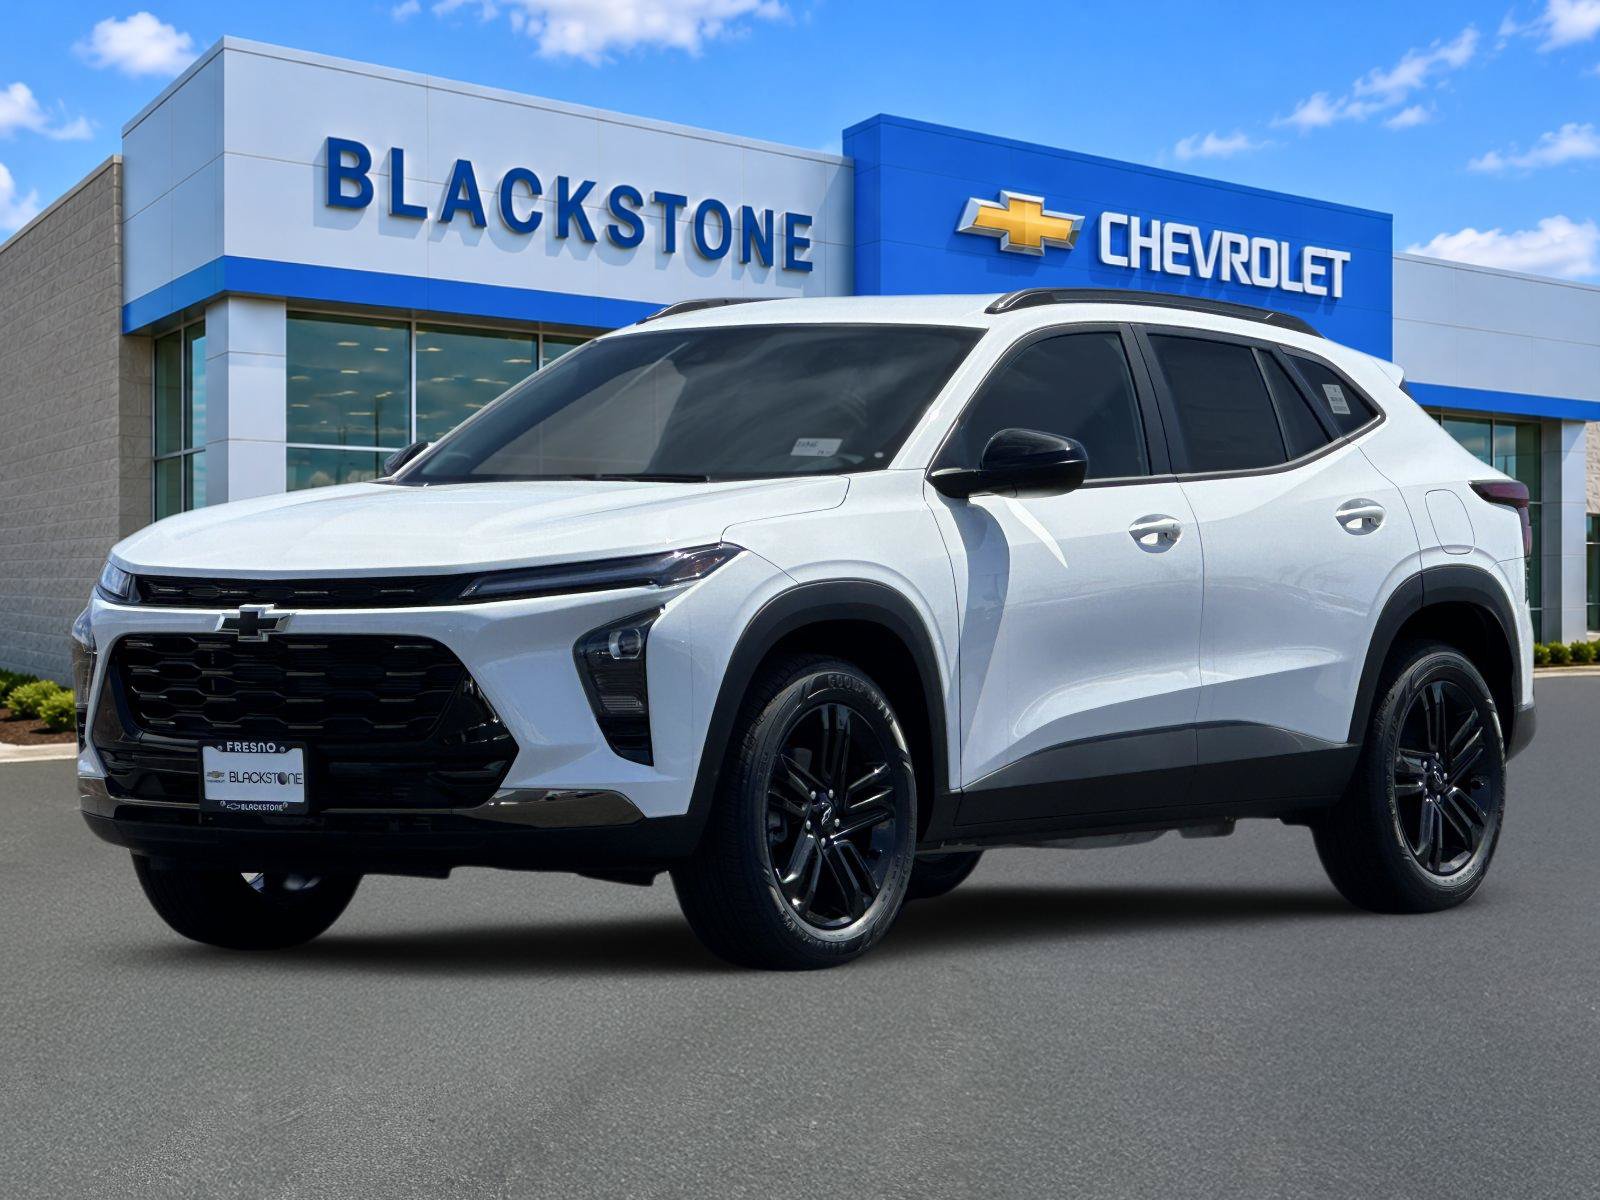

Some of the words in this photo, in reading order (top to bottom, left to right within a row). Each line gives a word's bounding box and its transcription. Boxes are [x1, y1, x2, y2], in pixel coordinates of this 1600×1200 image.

[325, 136, 814, 272] BLACKSTONE
[1099, 211, 1352, 298] CHEVROLET
[226, 741, 277, 753] FRESNO
[229, 771, 303, 785] BLACKSTONE
